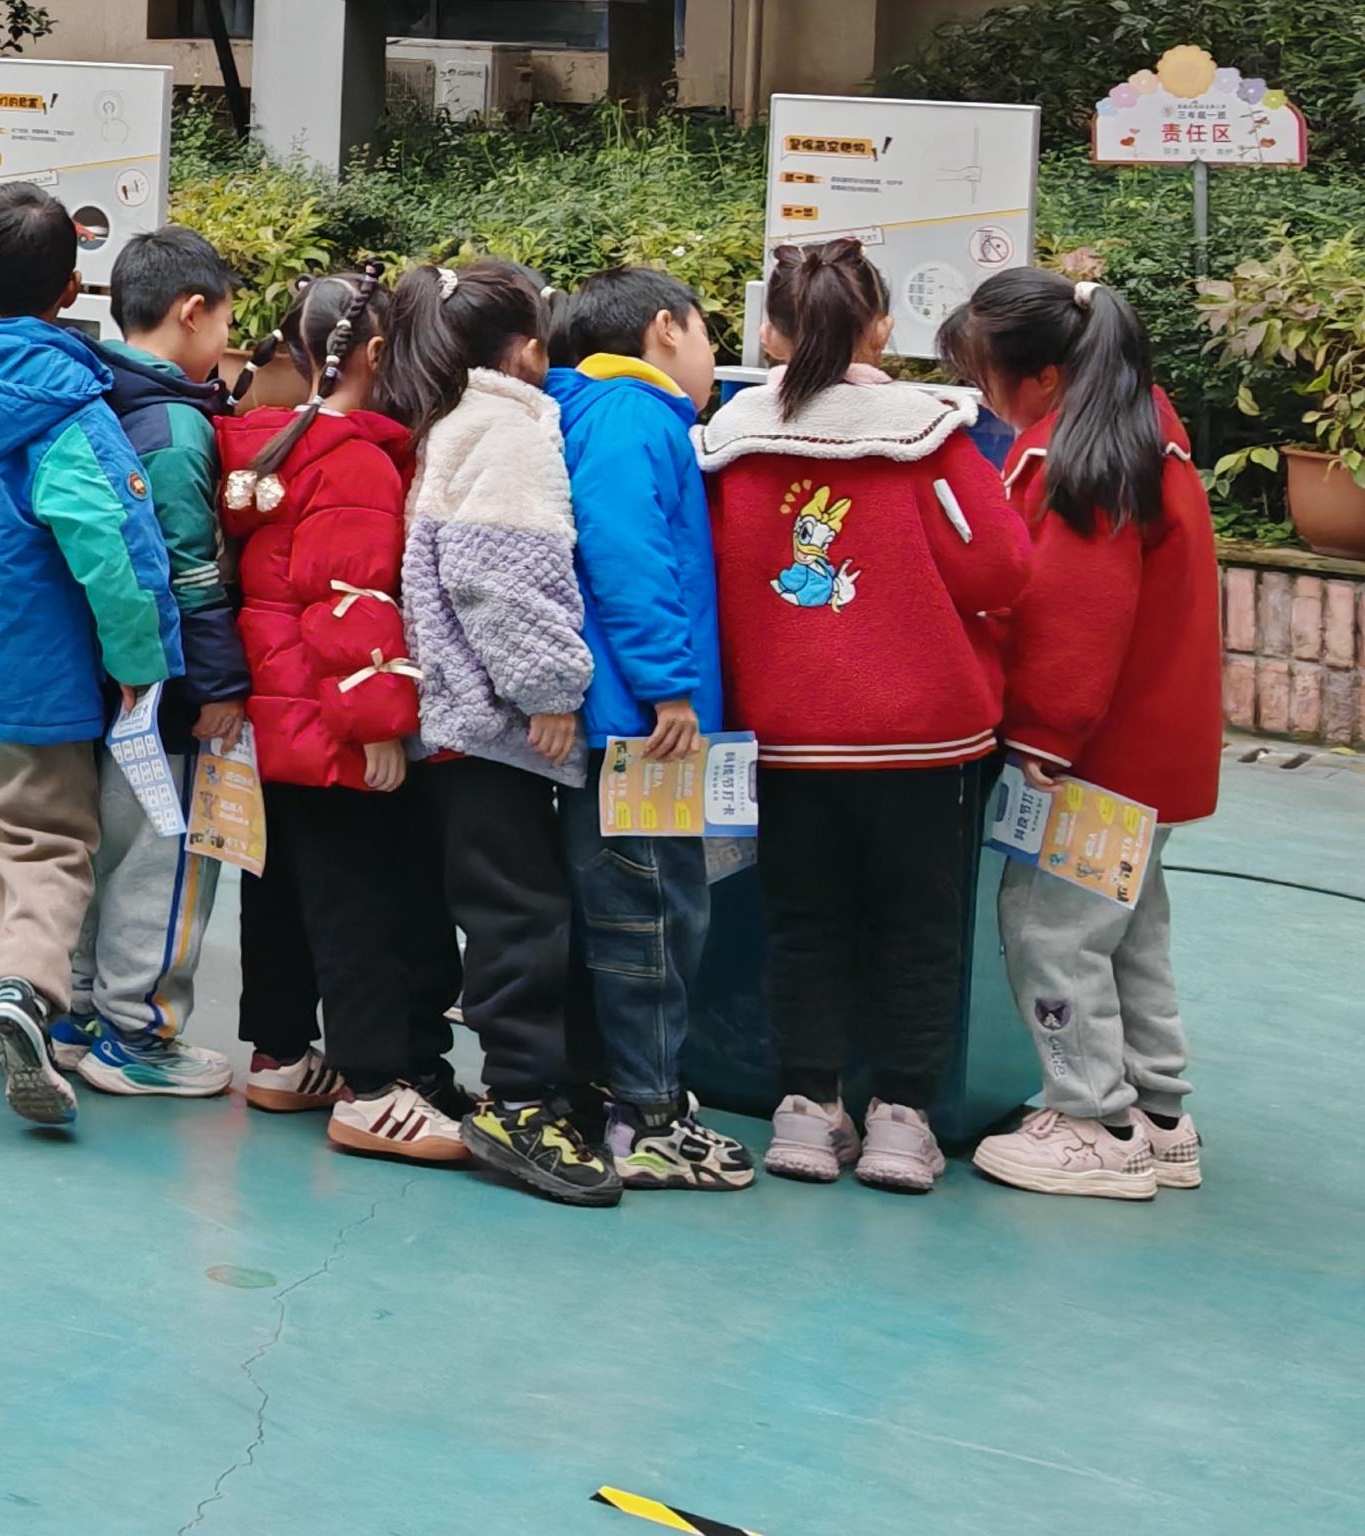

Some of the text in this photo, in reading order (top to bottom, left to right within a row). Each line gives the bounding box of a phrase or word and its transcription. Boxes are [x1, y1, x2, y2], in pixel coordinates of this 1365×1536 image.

[1161, 123, 1232, 143] 责任区
[722, 751, 736, 816] 科技节打卡
[1014, 787, 1035, 842] 科技节打
